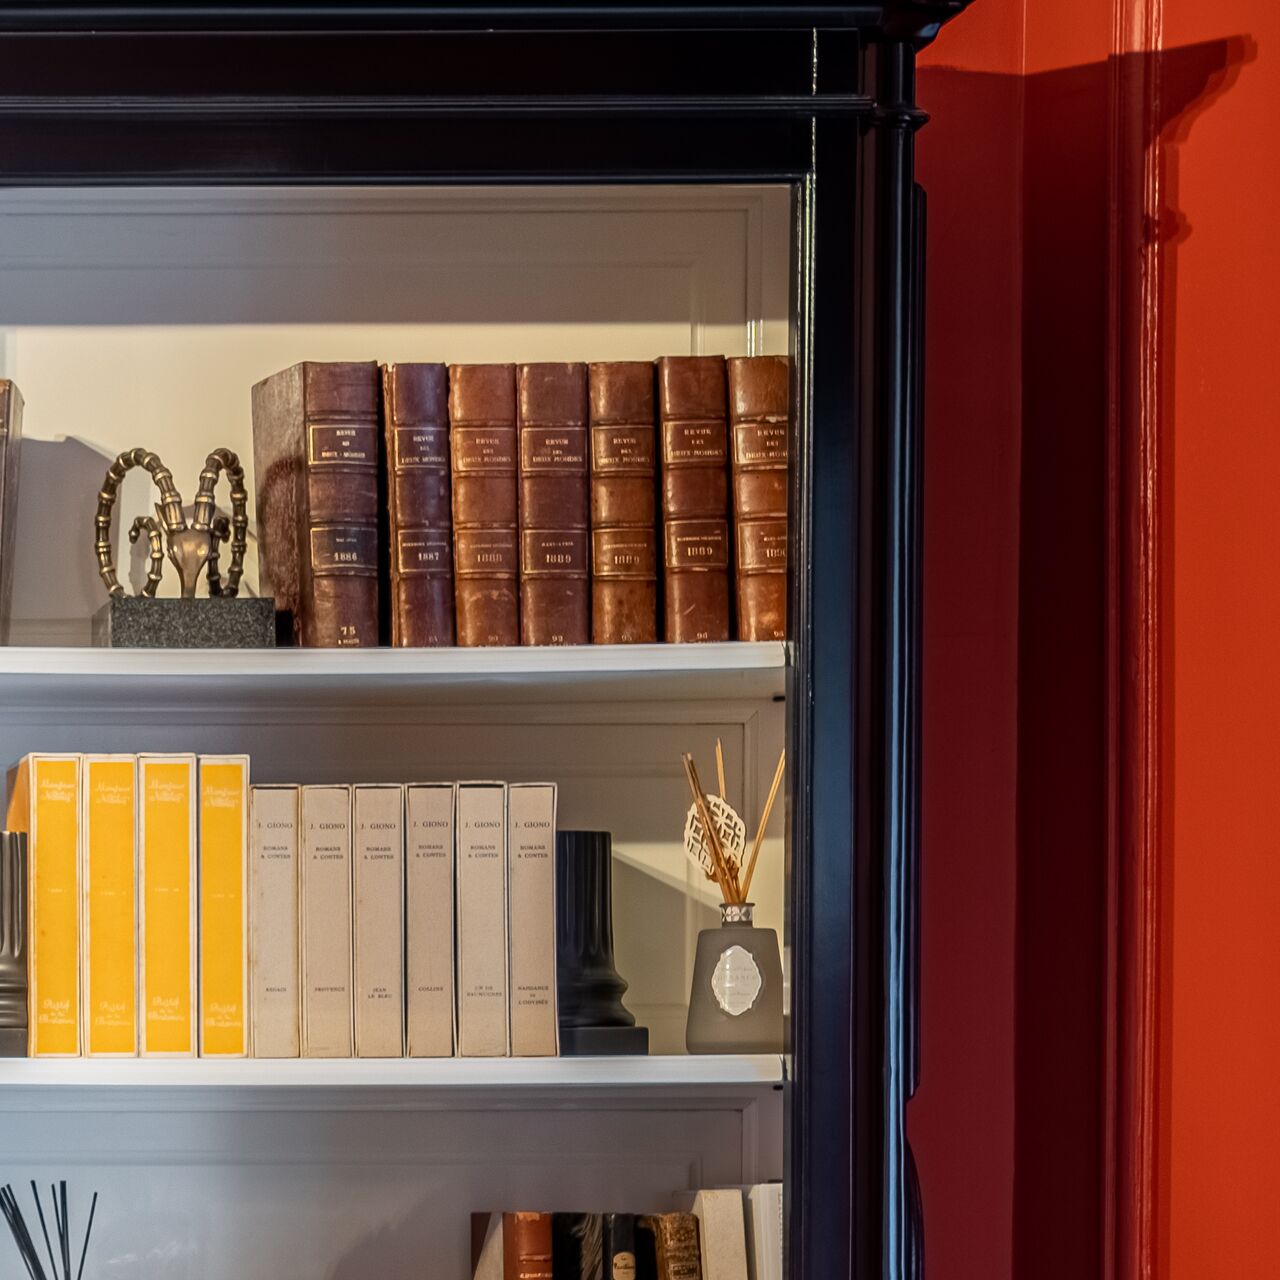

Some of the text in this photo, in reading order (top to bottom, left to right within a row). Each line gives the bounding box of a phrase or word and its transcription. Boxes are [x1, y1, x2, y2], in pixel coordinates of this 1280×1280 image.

[418, 552, 439, 560] 1887
[687, 547, 713, 556] 1889
[334, 552, 357, 561] 1886
[477, 553, 502, 562] 1888
[546, 554, 572, 563] 1889
[614, 555, 640, 564] 1889
[341, 626, 356, 635] 75
[422, 820, 449, 828] GIONO
[474, 821, 501, 829] GIONO
[524, 821, 550, 829] GIONO
